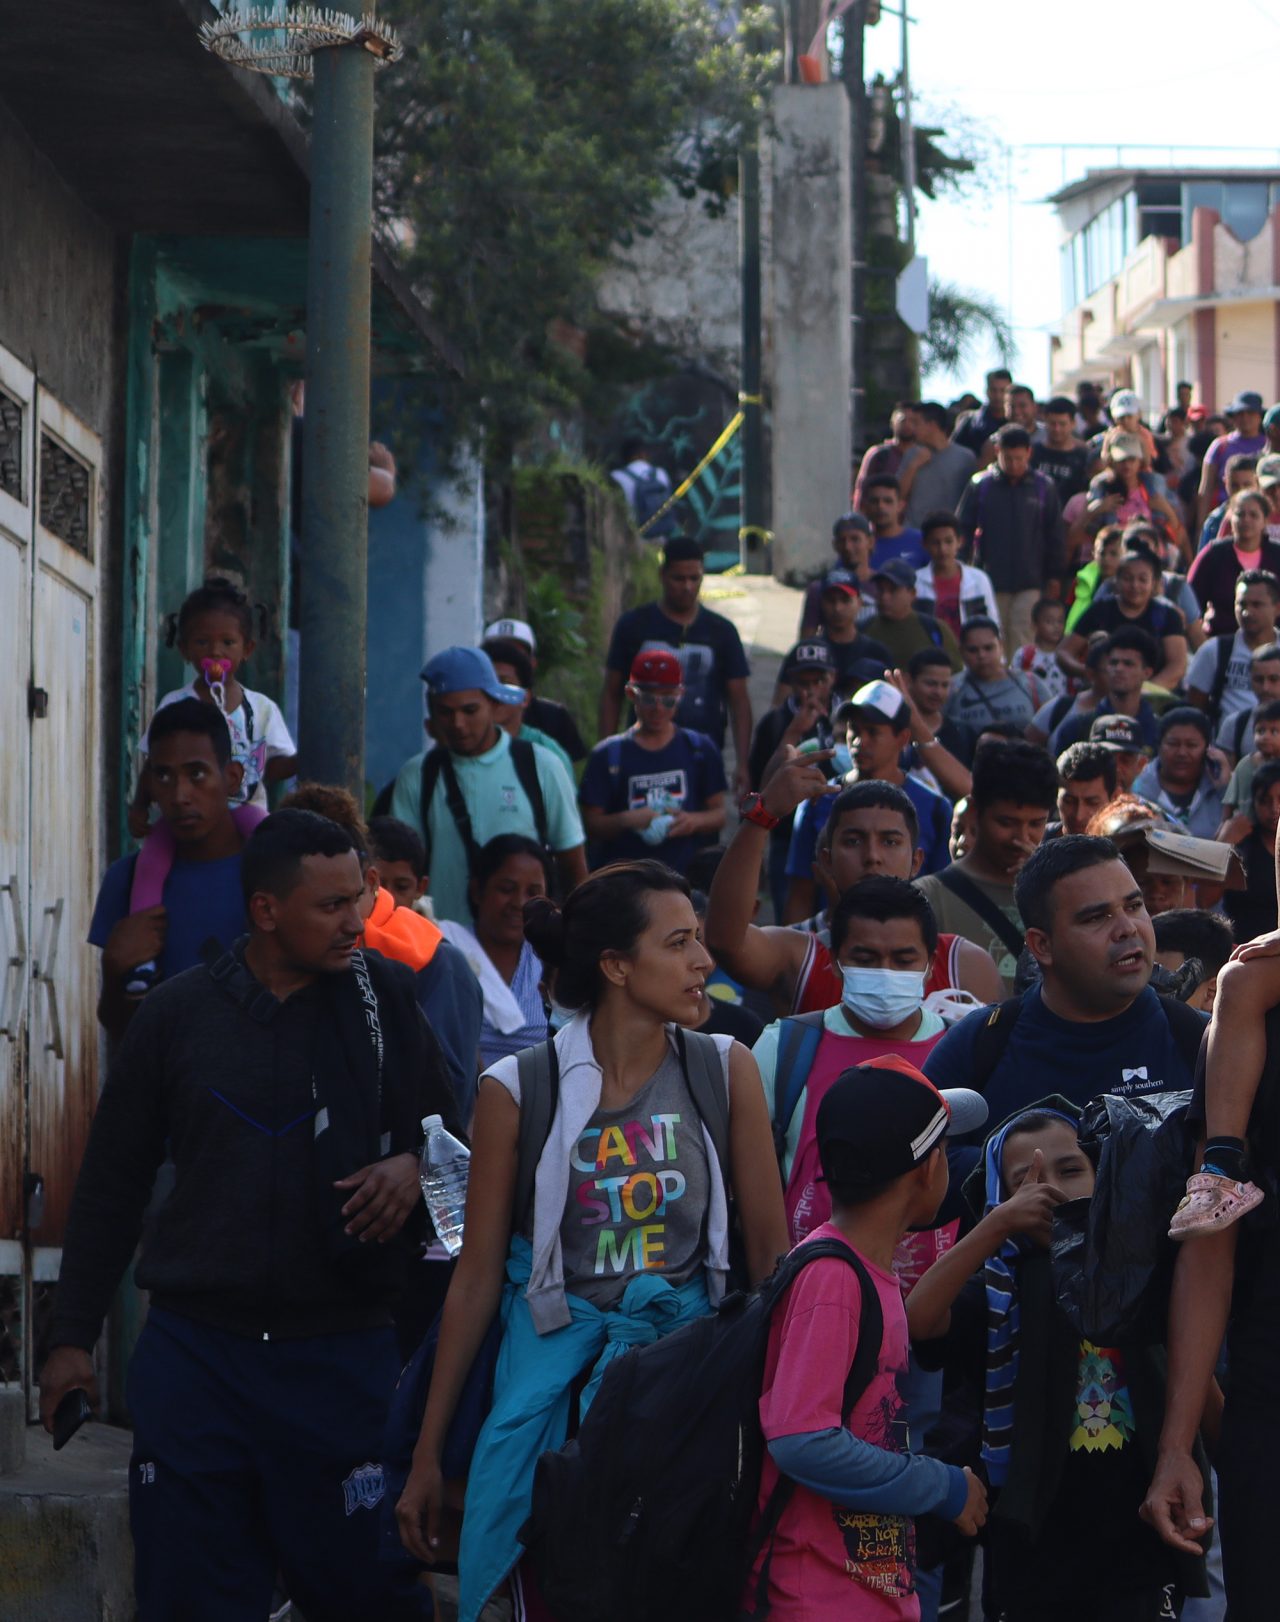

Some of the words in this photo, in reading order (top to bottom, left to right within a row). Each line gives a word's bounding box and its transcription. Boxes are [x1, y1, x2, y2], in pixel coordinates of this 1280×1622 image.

[1110, 1081, 1134, 1094] simply
[1135, 1079, 1164, 1090] southern
[570, 1113, 681, 1173] CANT
[576, 1169, 686, 1226] STOP
[594, 1223, 666, 1275] ME
